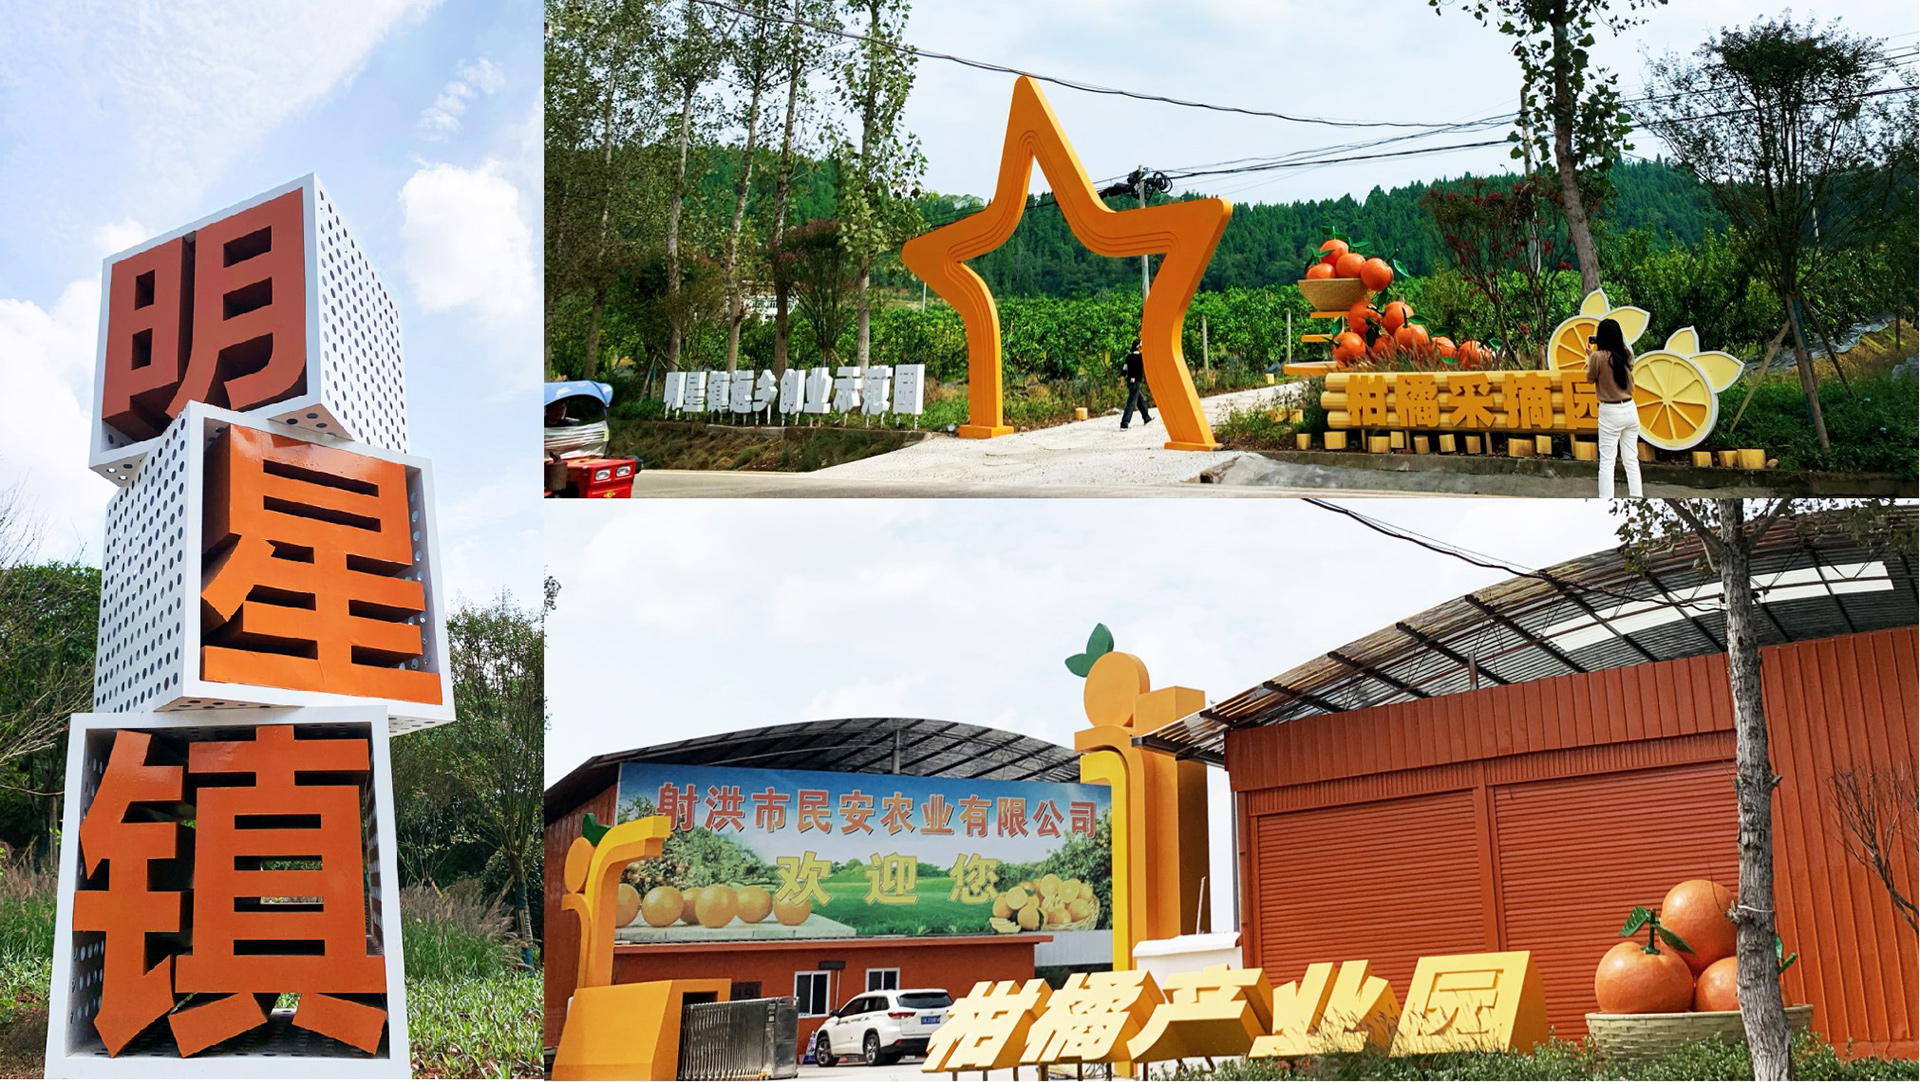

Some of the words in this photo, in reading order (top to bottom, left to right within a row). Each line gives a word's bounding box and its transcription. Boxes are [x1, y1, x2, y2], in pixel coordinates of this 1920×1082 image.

[1346, 371, 1599, 430] 柑橘采摘园
[73, 188, 442, 1058] 明星镇
[655, 782, 1097, 838] 射洪市民安农业有限公司
[775, 850, 999, 907] 欢迎您
[922, 951, 1533, 1073] 柑橘产业园
